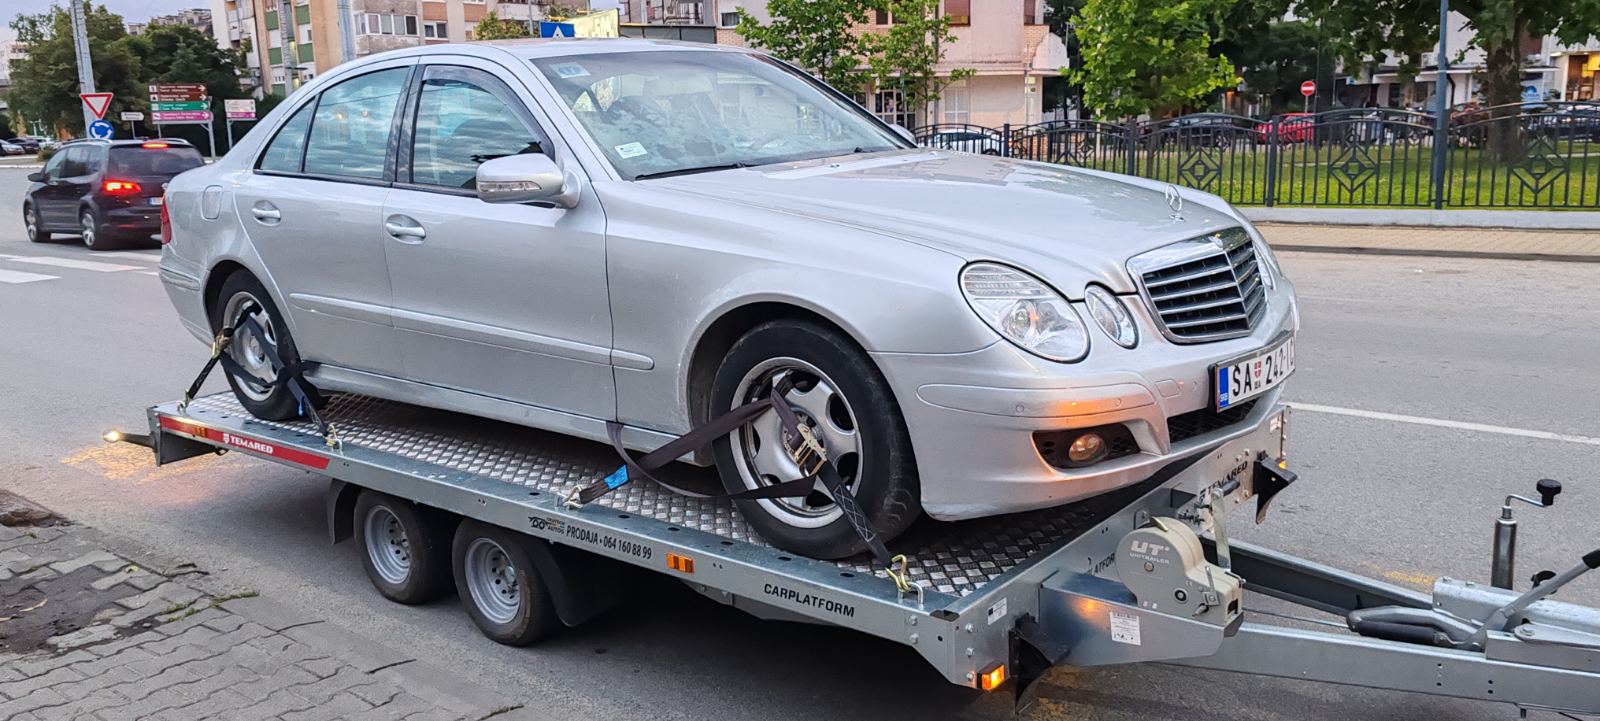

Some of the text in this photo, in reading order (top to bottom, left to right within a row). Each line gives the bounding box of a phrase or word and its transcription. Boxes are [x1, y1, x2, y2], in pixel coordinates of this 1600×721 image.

[1232, 363, 1252, 397] ŠA
[229, 434, 274, 454] TEMARED
[566, 525, 652, 560] PRODAJA 064 160 88 99
[1129, 552, 1170, 565] UNITRAILER
[764, 583, 855, 618] CARPLATFORM
